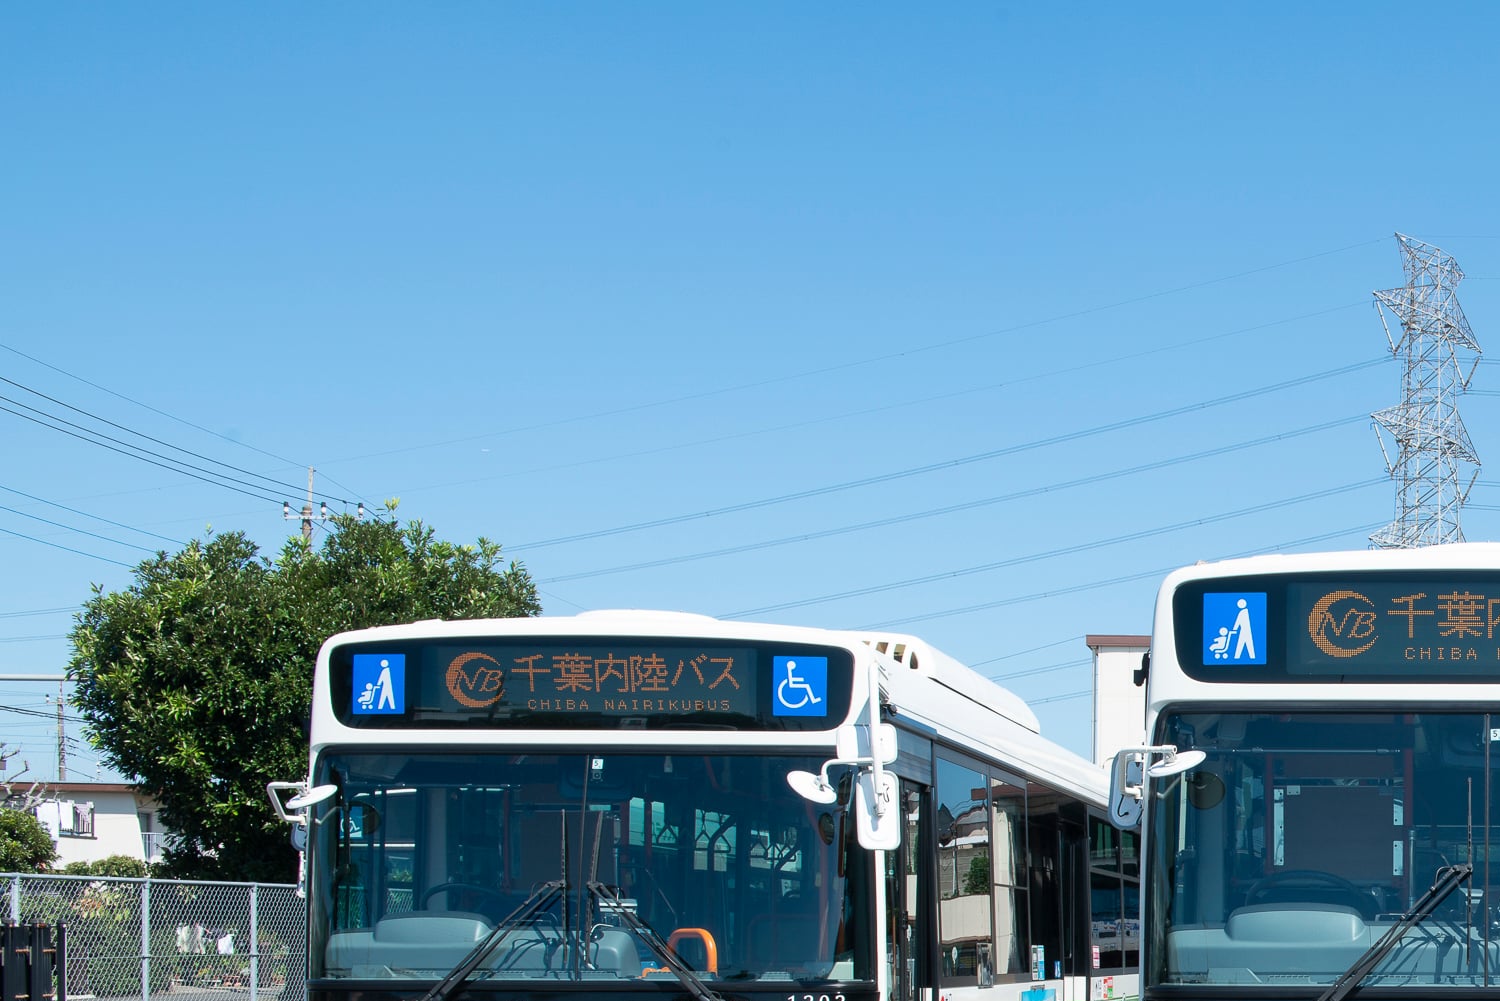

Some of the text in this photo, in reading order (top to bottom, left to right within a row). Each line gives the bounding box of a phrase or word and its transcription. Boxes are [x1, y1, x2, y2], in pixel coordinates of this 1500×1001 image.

[1405, 647, 1478, 661] CHIBA
[511, 652, 740, 693] 千葉内陸バス
[527, 699, 730, 711] CHIBA NAIRIKUBUS
